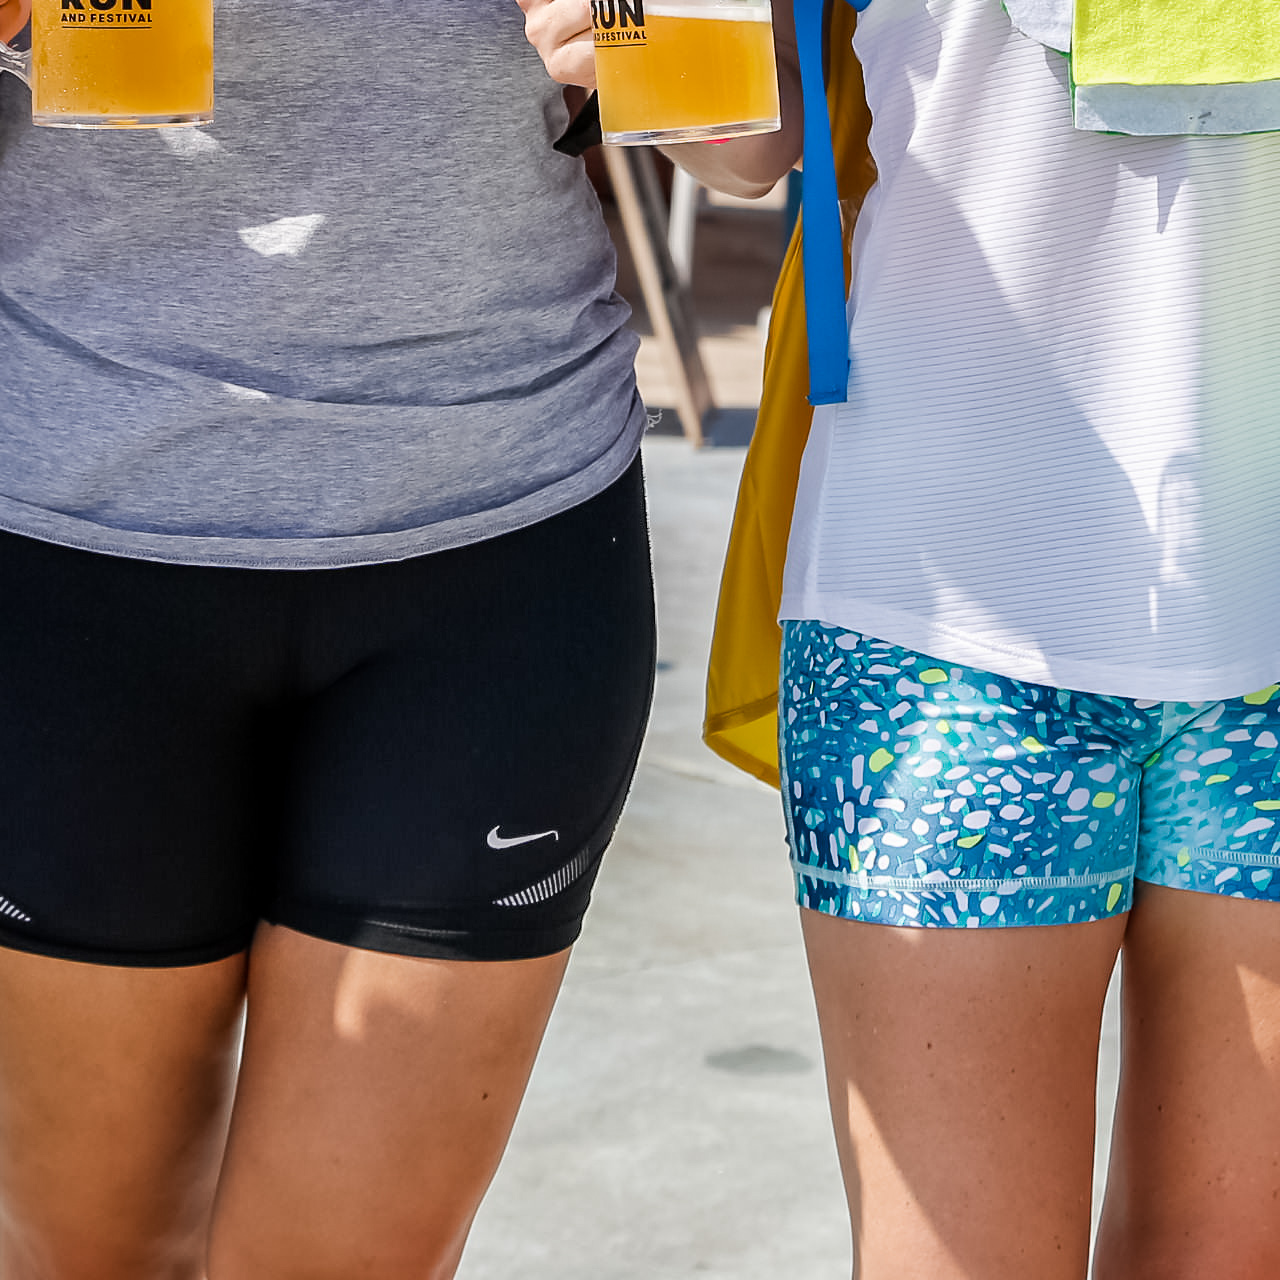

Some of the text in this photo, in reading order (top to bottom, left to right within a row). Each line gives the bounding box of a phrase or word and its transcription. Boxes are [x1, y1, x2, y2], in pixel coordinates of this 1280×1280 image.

[60, 12, 153, 23] AND FESTIVAL
[601, 30, 648, 42] FESTIVAL
